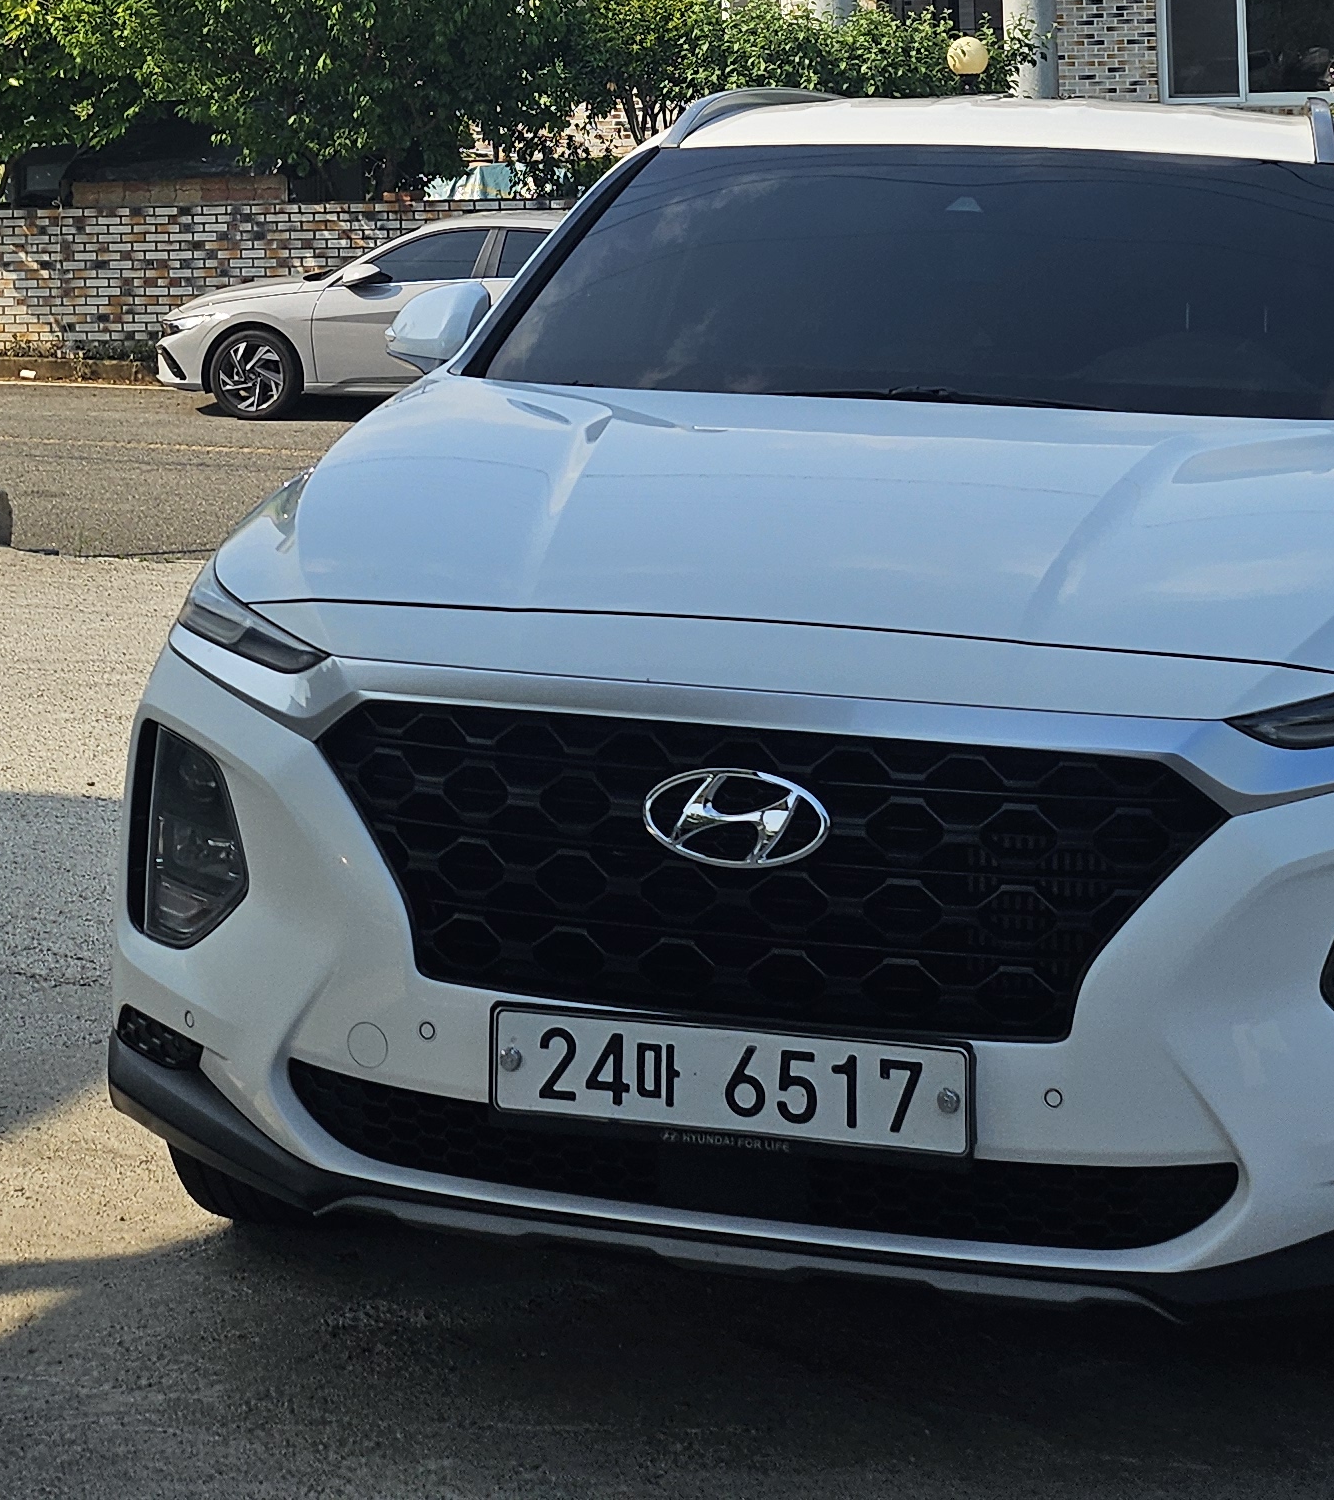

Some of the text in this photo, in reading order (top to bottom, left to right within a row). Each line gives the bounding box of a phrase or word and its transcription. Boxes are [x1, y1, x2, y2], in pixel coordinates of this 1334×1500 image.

[538, 1027, 923, 1133] 24마 6517
[682, 1132, 790, 1153] HYUNDAI FOR LIFE
